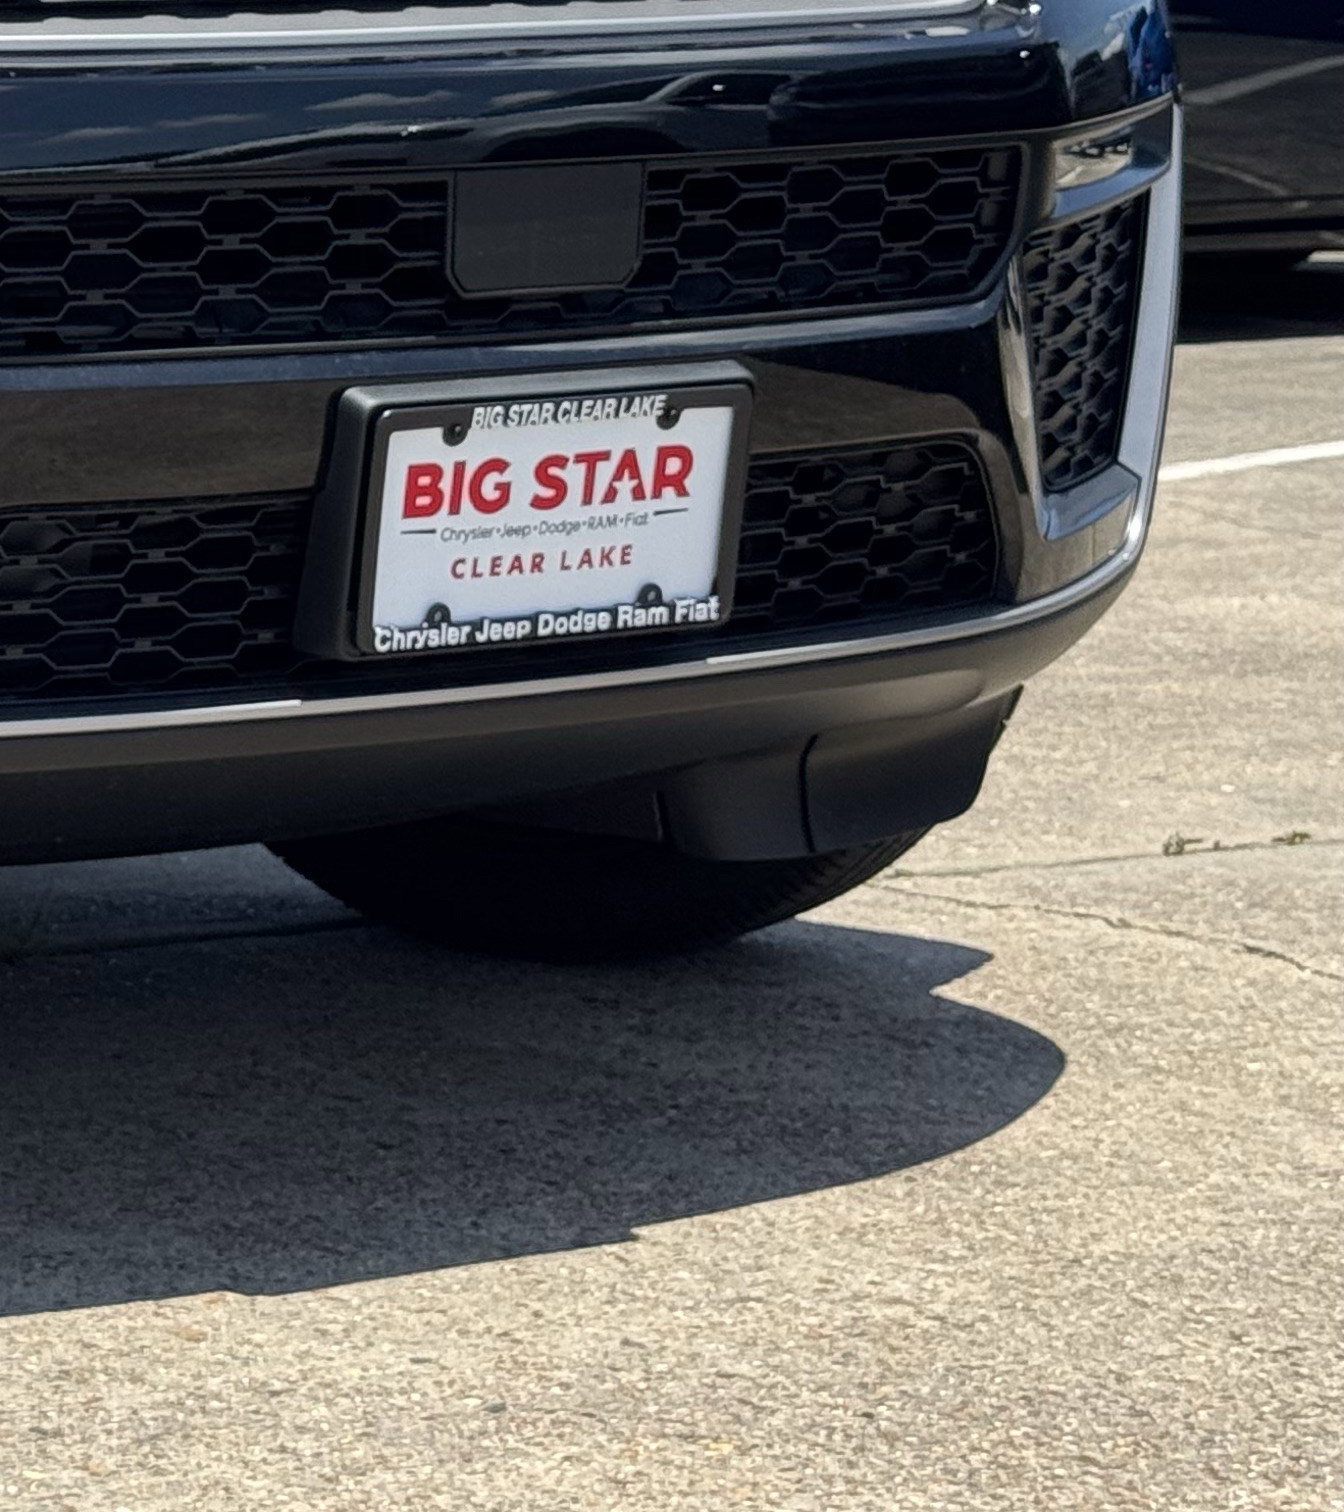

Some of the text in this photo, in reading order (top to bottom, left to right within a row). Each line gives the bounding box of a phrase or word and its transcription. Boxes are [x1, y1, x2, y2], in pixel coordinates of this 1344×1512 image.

[471, 394, 669, 429] BIG STAR CLEAR LAKE
[401, 444, 694, 520] BIG STAR
[450, 544, 633, 579] CLEAR LAKE
[374, 595, 720, 653] Chrysler Jeep Dodge Ram Fiat
